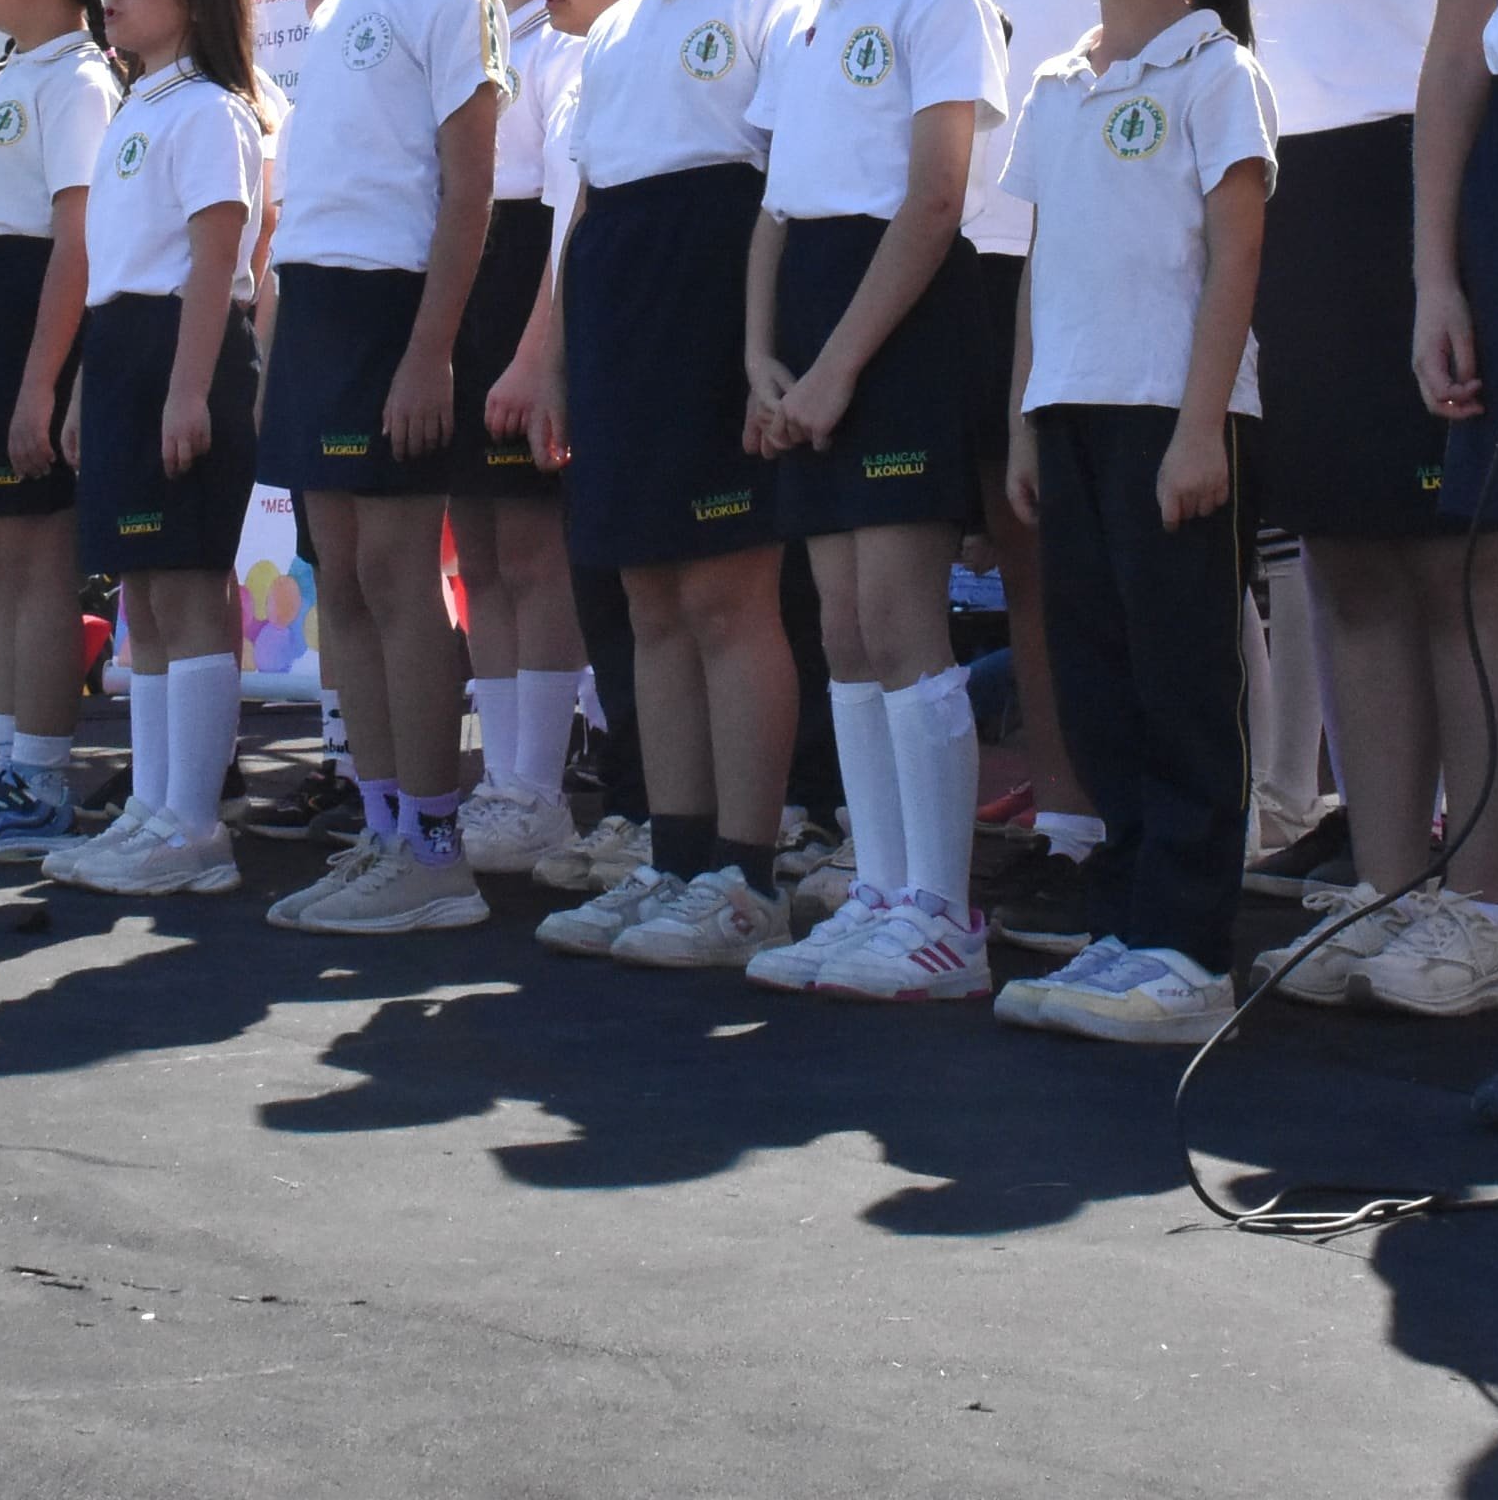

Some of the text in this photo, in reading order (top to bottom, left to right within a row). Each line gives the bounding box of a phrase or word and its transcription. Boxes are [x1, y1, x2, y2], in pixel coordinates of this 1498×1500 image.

[256, 29, 285, 50] ÇILIŞ
[862, 450, 928, 467] ALSANCAK
[866, 463, 924, 479] İLKOKULU
[695, 501, 751, 521] İLKOKULU
